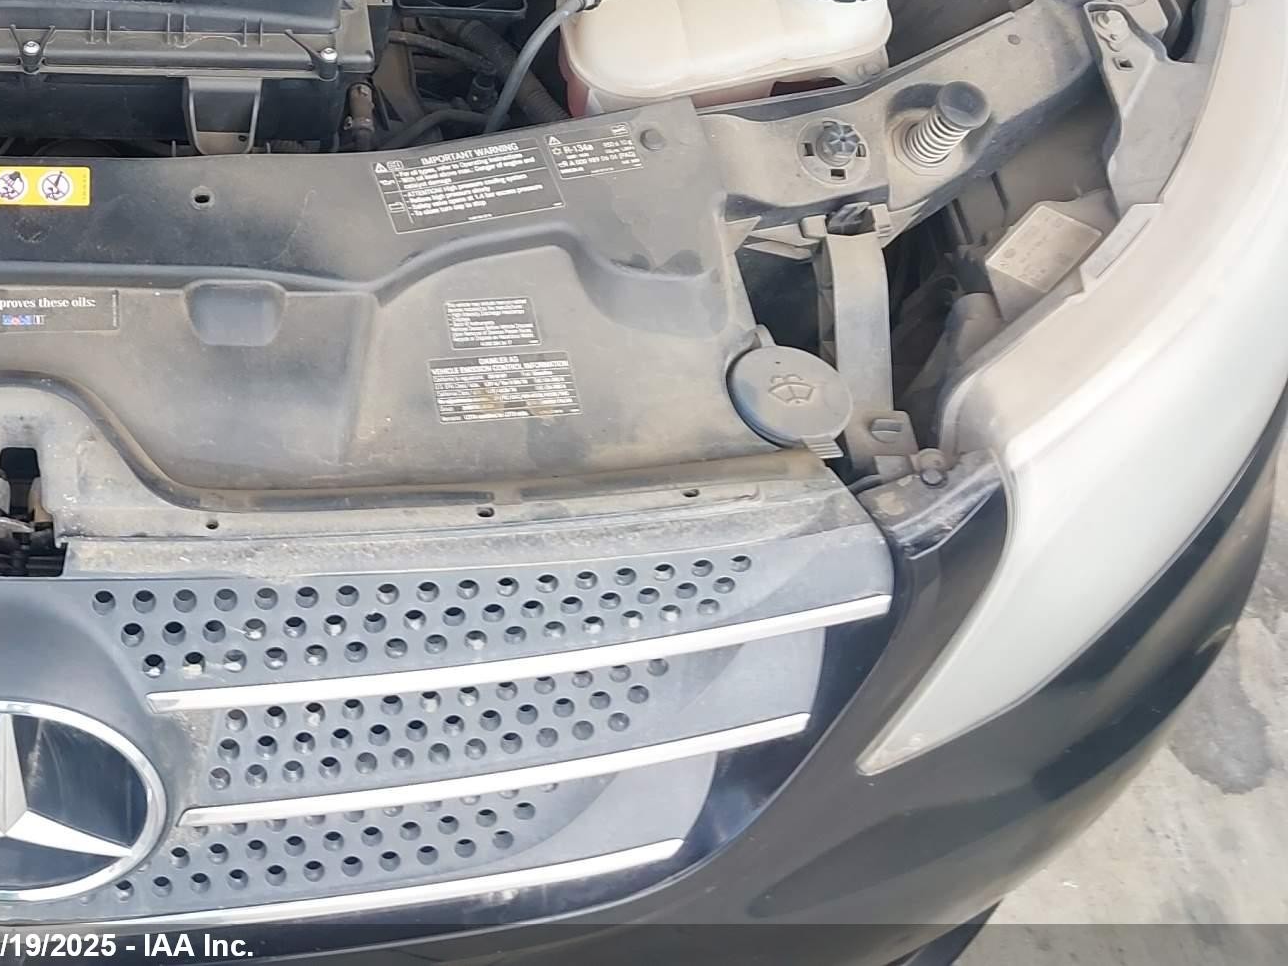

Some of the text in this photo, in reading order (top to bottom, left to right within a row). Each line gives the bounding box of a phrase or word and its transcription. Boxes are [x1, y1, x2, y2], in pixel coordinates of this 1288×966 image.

[421, 143, 519, 165] IMPORTANT WARNING
[38, 297, 69, 308] these
